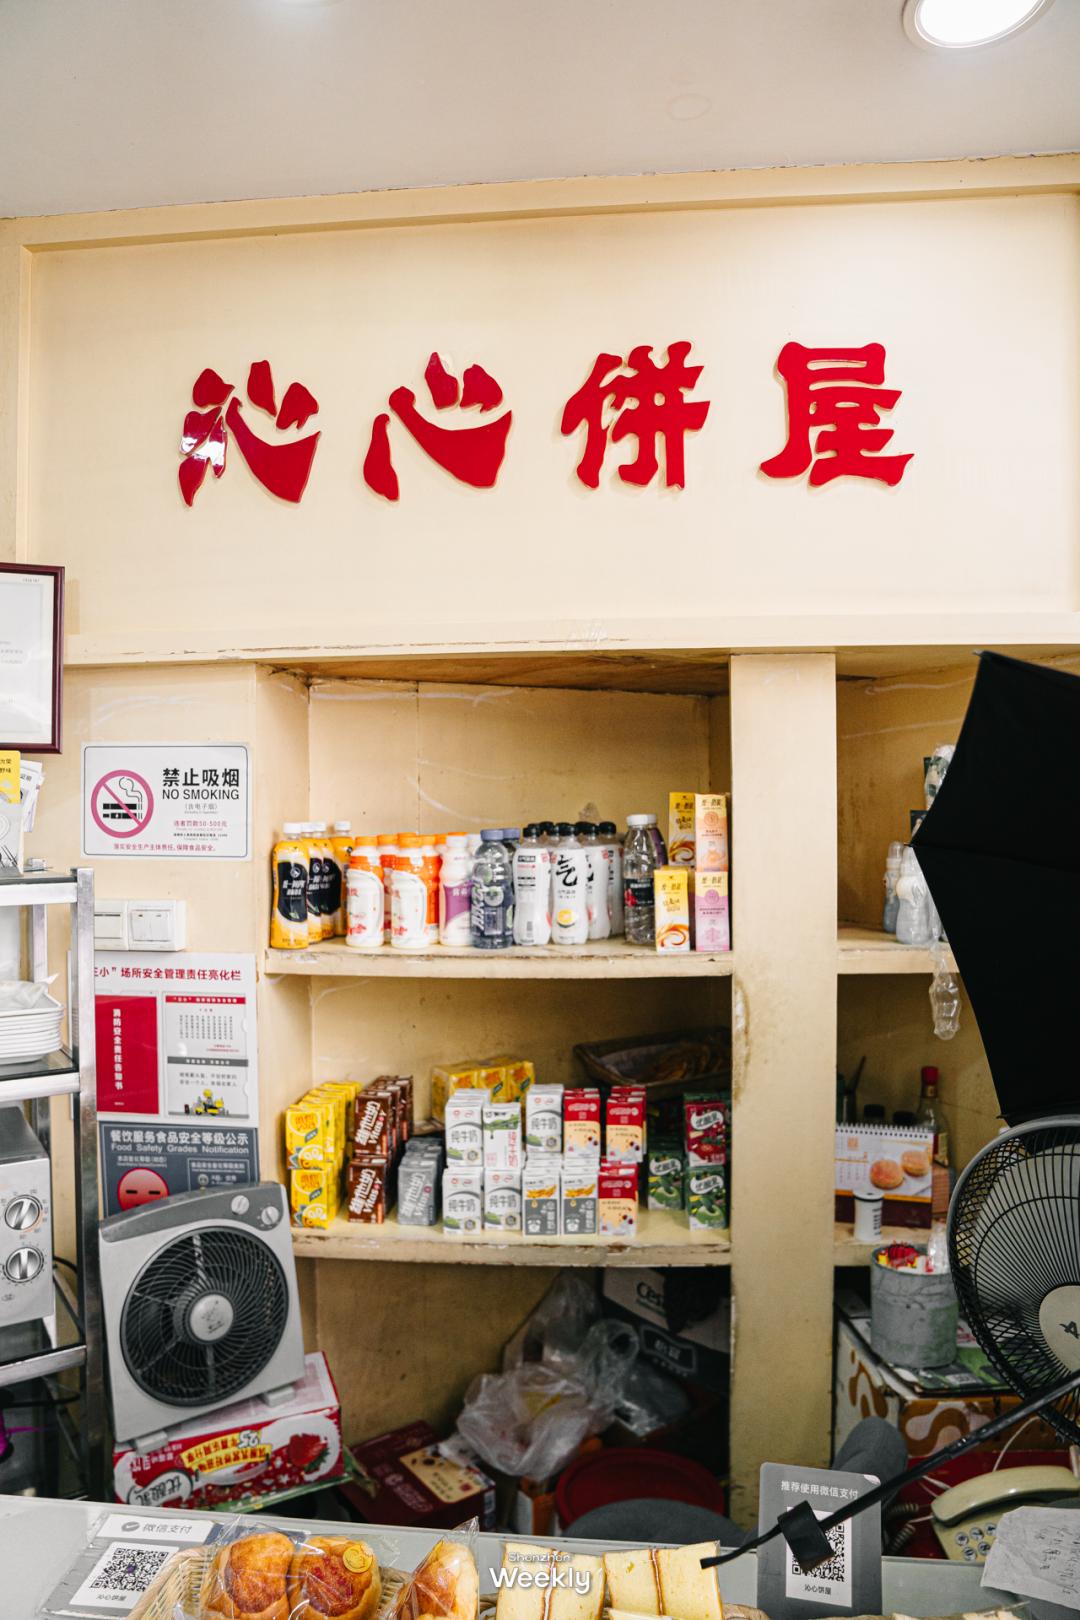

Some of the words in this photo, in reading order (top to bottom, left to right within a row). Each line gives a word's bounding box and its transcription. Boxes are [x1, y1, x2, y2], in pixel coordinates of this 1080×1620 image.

[162, 768, 239, 787] 禁止吸烟
[162, 789, 179, 800] NO
[183, 789, 239, 800] SMOKING
[110, 1130, 249, 1145] 餐饮服务食品安全等级公示
[111, 1143, 132, 1151] Food
[136, 1143, 163, 1154] Safety
[167, 1144, 198, 1153] Grades
[202, 1144, 249, 1154] Notification
[781, 1481, 858, 1500] 推荐使用微信支付
[142, 1523, 192, 1534] 微信支付
